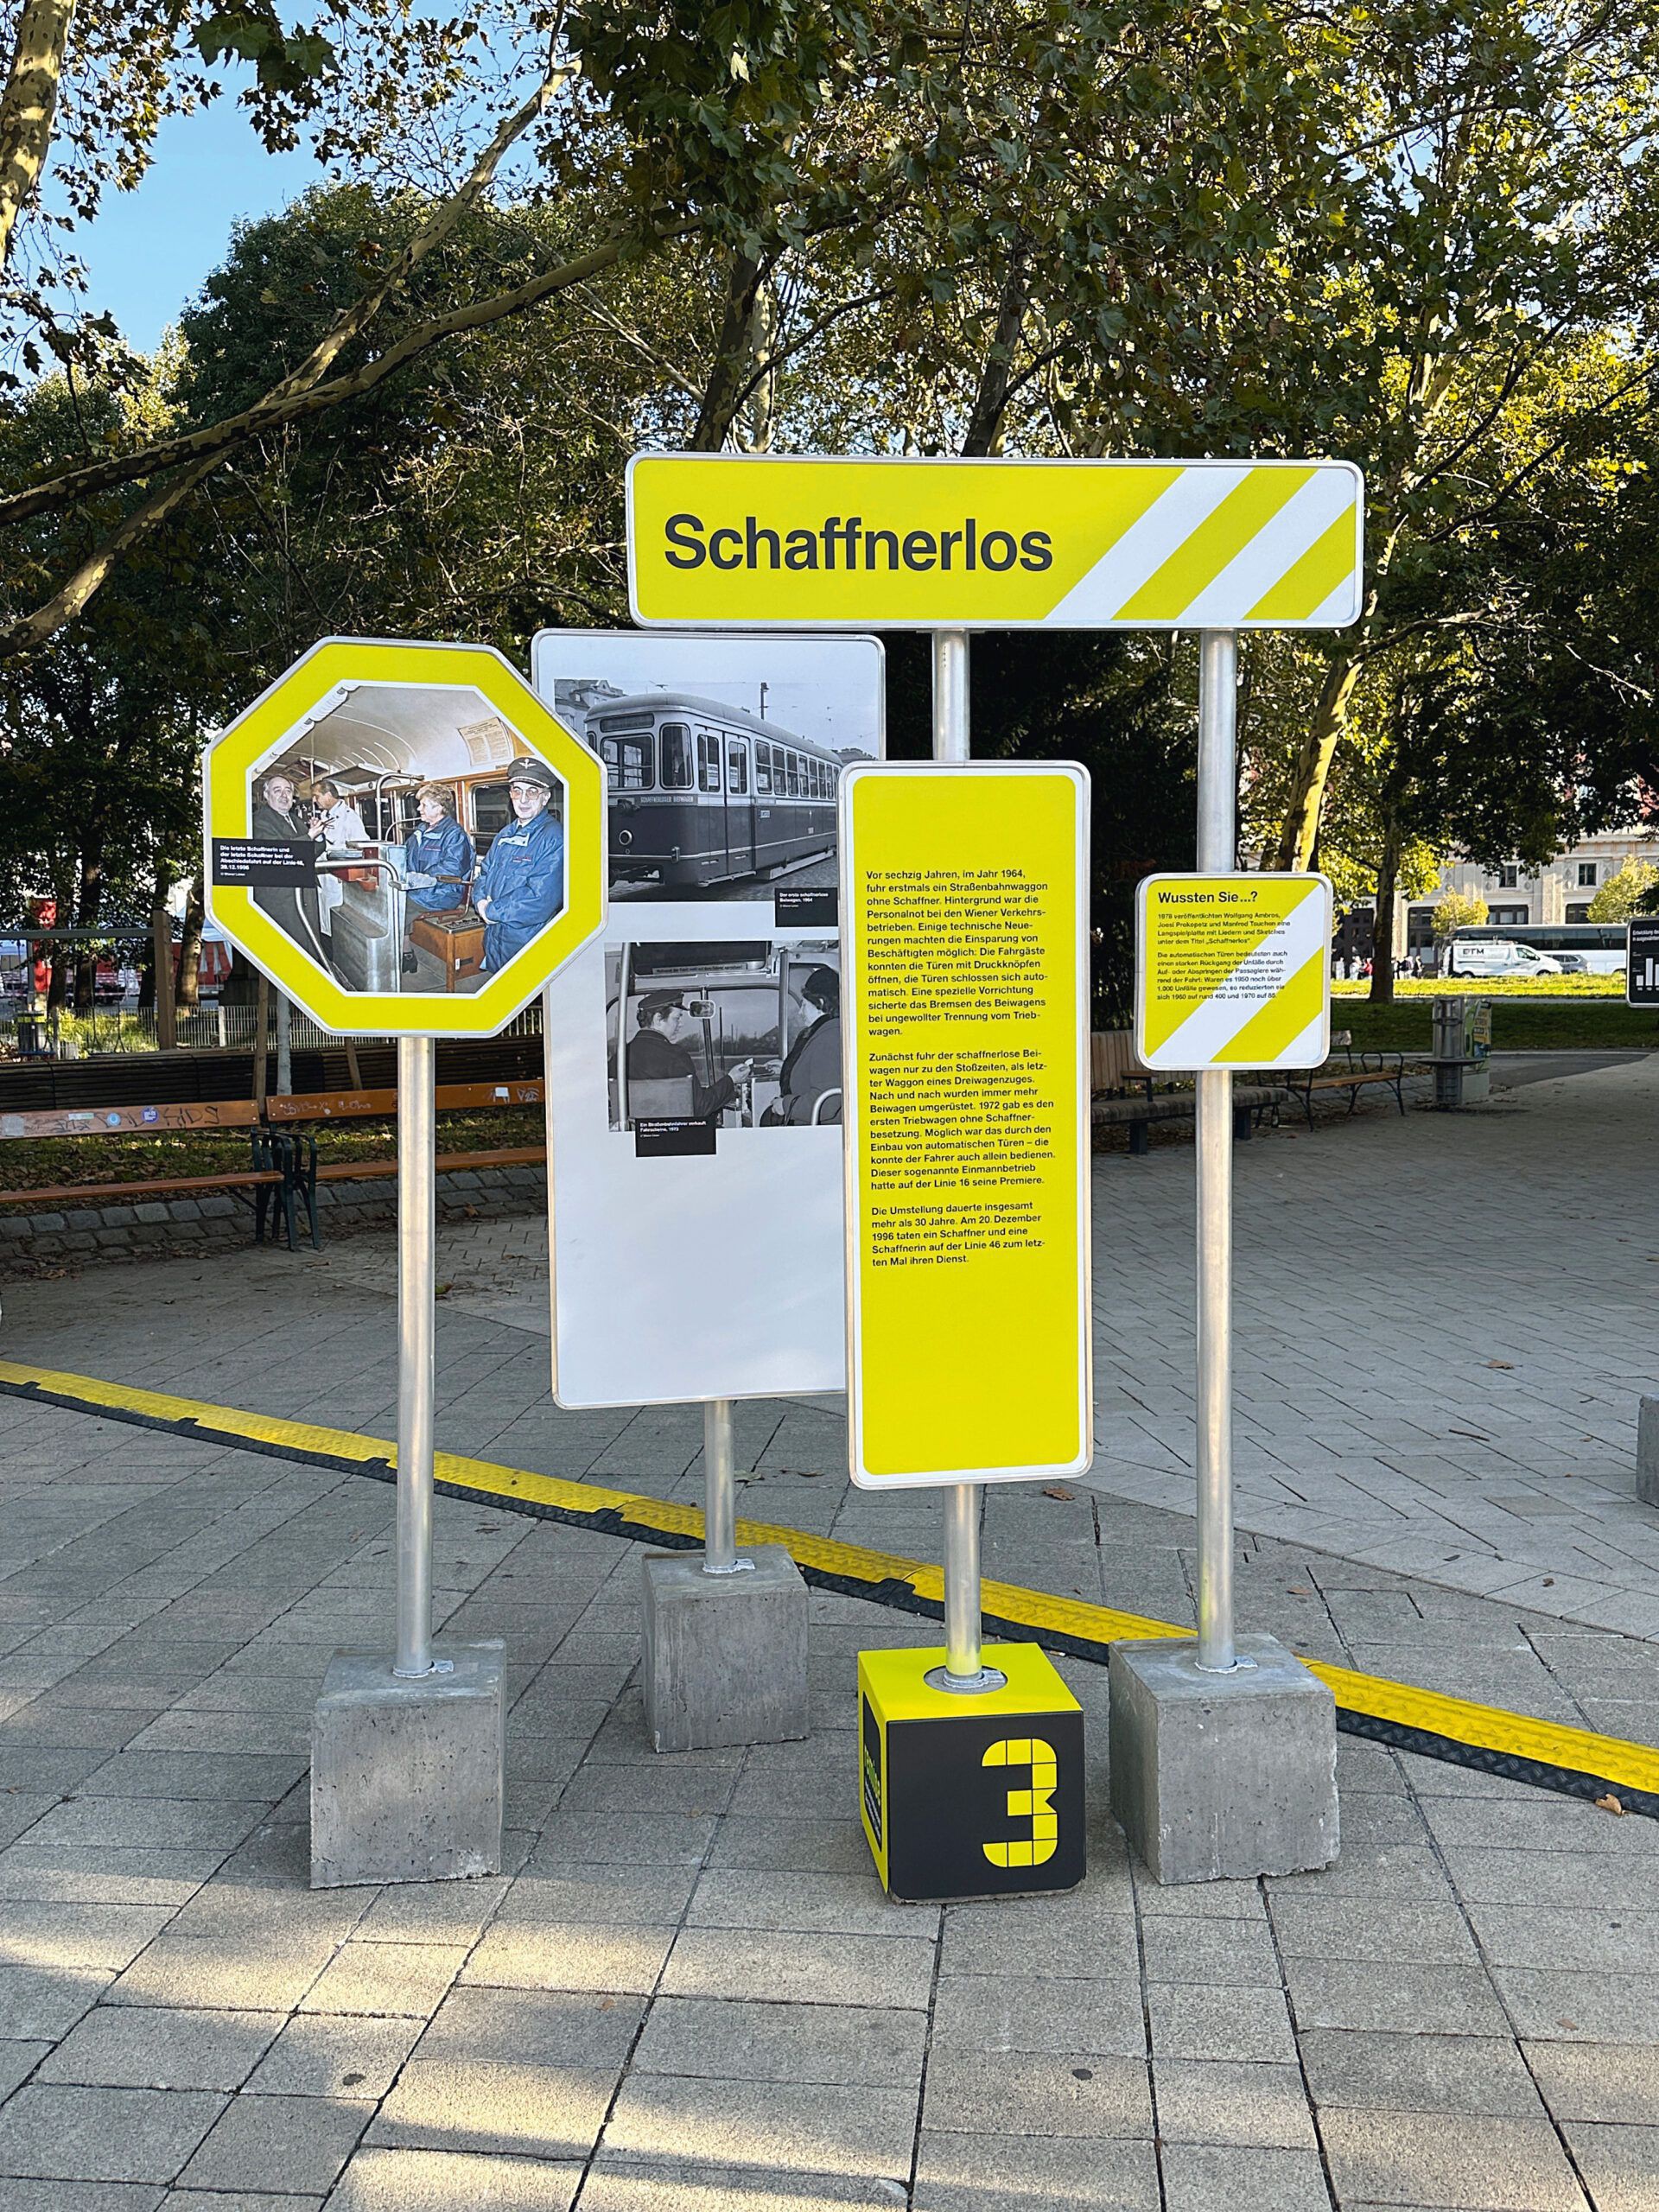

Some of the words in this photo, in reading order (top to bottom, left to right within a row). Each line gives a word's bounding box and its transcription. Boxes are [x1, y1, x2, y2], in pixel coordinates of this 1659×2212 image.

[664, 514, 1053, 572] Schaffnerlos
[886, 871, 921, 880] sechzig
[925, 870, 960, 880] Jahren,
[1001, 869, 1025, 878] 1964,
[867, 884, 886, 893] fuhr
[950, 882, 1047, 893] Straßenbahnwaggon
[945, 895, 1001, 906] Hintergrund
[1158, 893, 1214, 903] Wussten
[868, 910, 925, 918] Personalnot
[944, 909, 962, 918] den
[868, 923, 915, 931] betrieben.
[918, 923, 947, 932] Einige
[948, 935, 962, 944] die
[965, 935, 1018, 944] Einsparung
[868, 949, 934, 958] Beschäftigten
[937, 948, 976, 958] möglich:
[998, 947, 1045, 957] Fahrgäste
[909, 962, 923, 970] die
[974, 960, 1040, 969] Druckknöpfen
[868, 976, 901, 984] öffnen,
[904, 975, 918, 983] die
[935, 987, 976, 997] spezielle
[979, 986, 1033, 995] Vorrichtung
[995, 999, 1046, 1007] Beiwagens
[886, 1014, 941, 1024] ungewollter
[944, 1013, 988, 1021] Trennung
[869, 1052, 913, 1061] Zunächst
[957, 1050, 1020, 1059] schaffnerlose
[869, 1067, 900, 1076] wagen
[885, 1078, 924, 1088] Waggon
[955, 1077, 1034, 1087] Dreiwagenzuges.
[890, 1205, 943, 1215] Umstellung
[946, 1204, 982, 1212] dauerte
[985, 1202, 1033, 1213] insgesamt
[929, 1217, 957, 1226] Jahre.
[995, 1214, 1041, 1223] Dezember
[873, 1232, 893, 1241] 1996
[940, 1229, 986, 1238] Schaffner
[873, 1244, 926, 1254] Schaffnerin
[929, 1243, 944, 1251] auf
[890, 1257, 907, 1266] Mal
[937, 1255, 968, 1263] Dienst.
[982, 1738, 1058, 1867] 3
